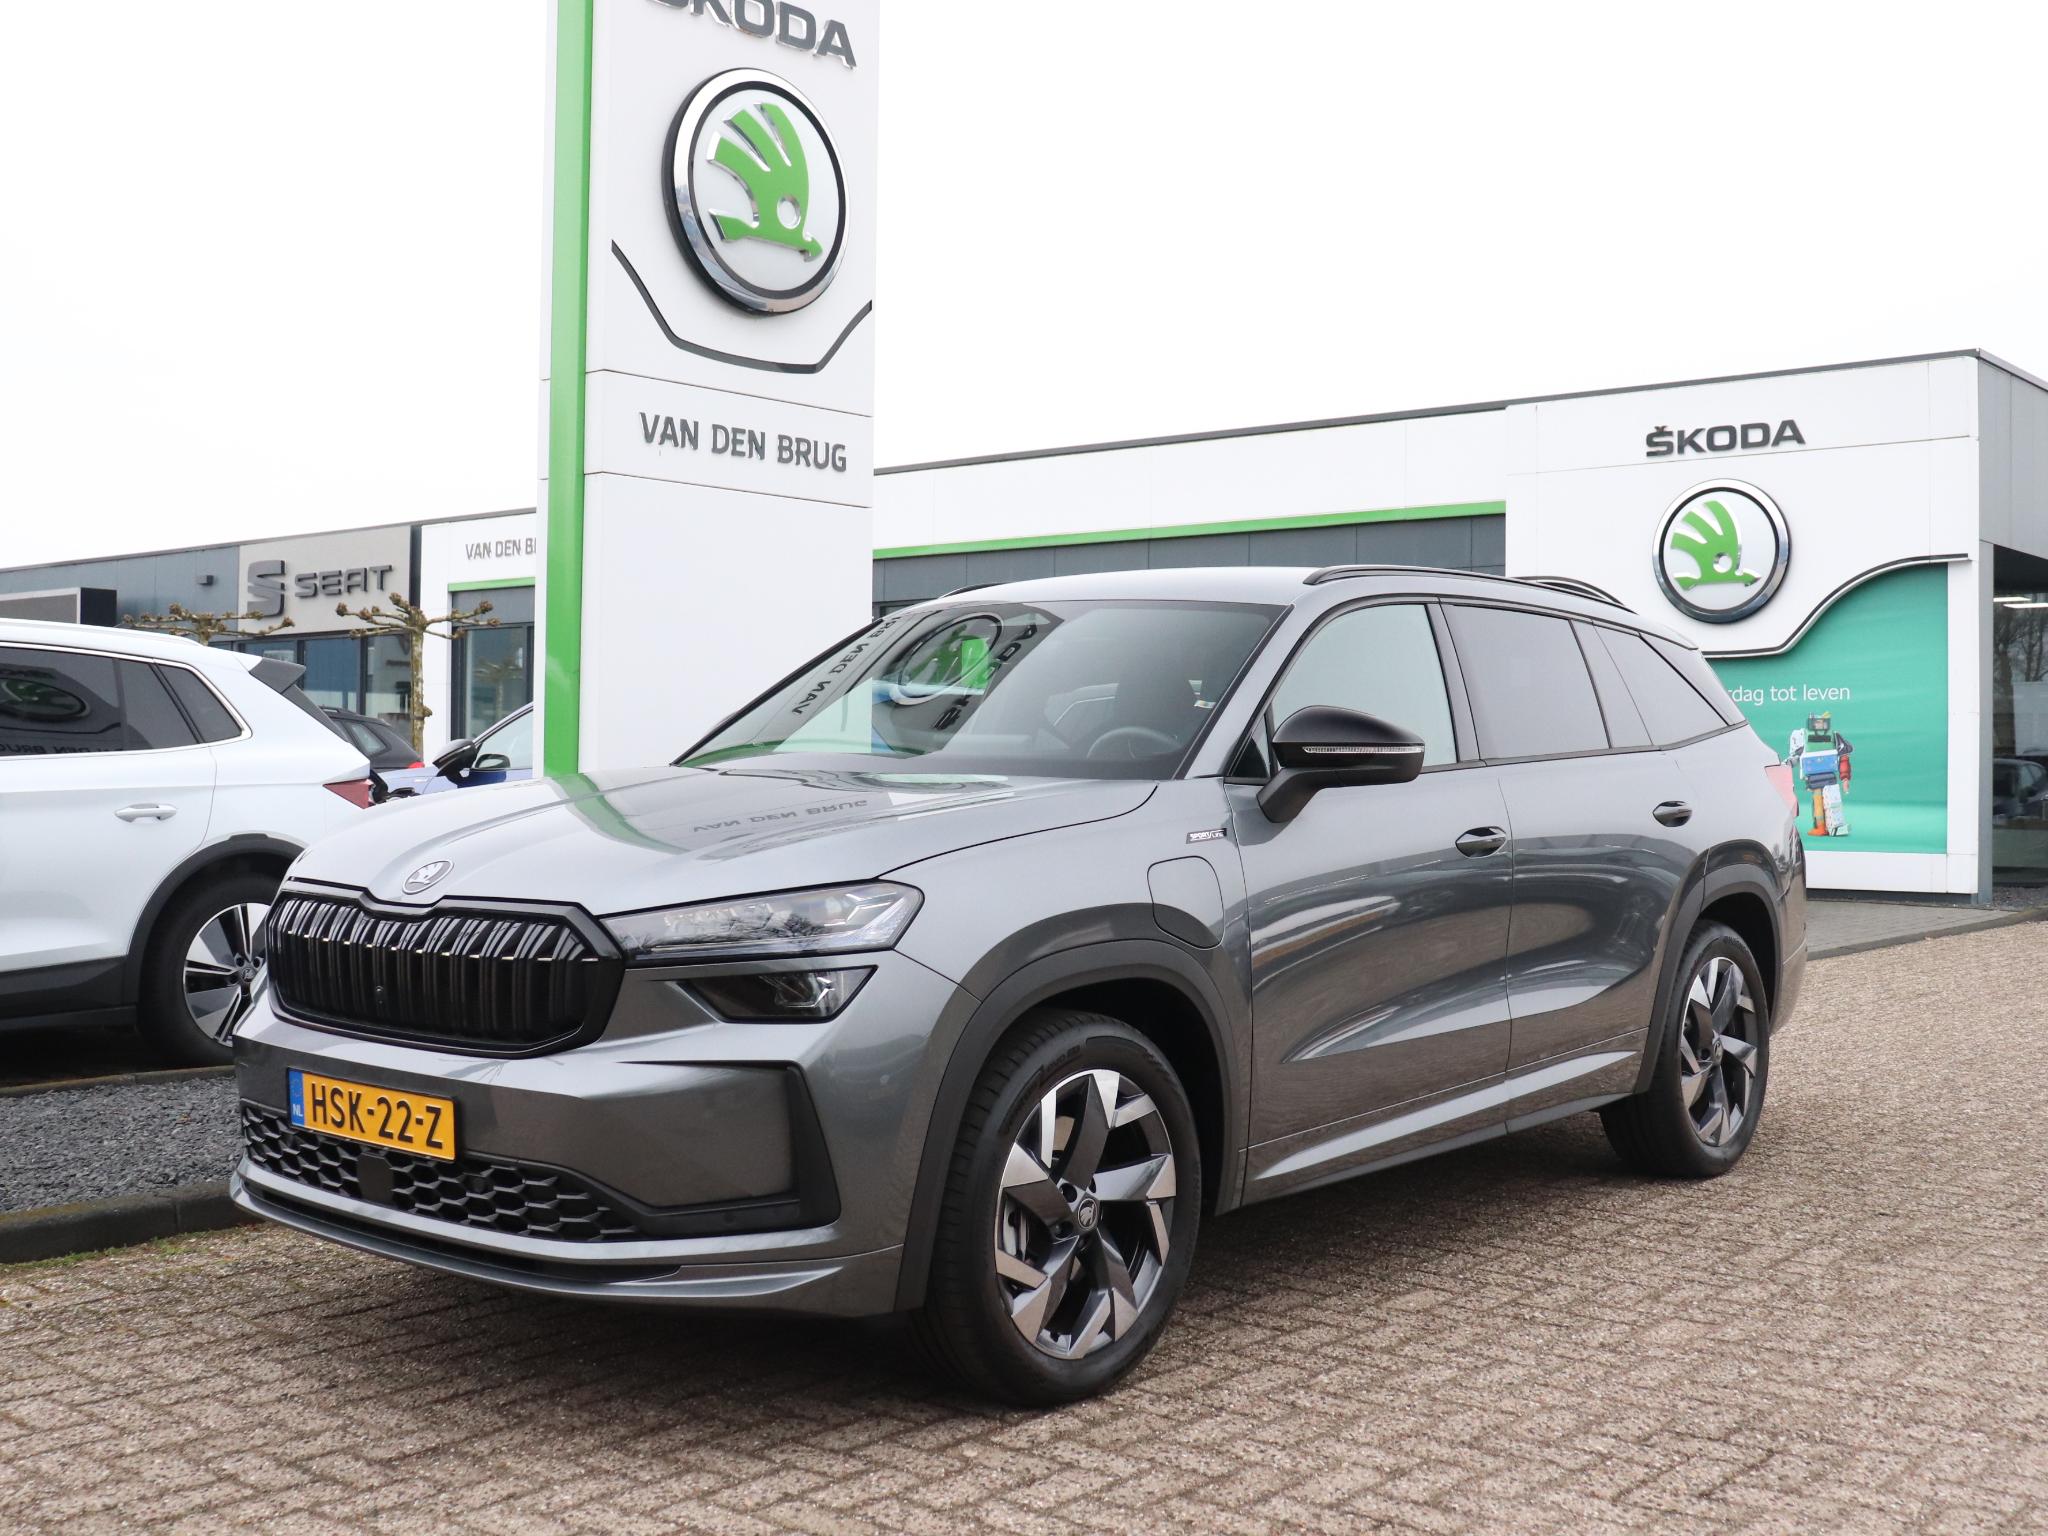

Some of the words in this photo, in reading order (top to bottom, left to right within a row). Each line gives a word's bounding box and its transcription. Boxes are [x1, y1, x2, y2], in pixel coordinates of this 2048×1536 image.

[639, 411, 699, 450] VAN
[711, 423, 766, 460] DEN
[777, 434, 847, 473] BRUG
[1646, 419, 1806, 457] ŠKODA
[465, 541, 492, 560] VAN
[495, 539, 521, 558] DEN
[525, 537, 537, 555] B
[294, 564, 393, 598] SEAT
[1769, 685, 1797, 701] tot
[1803, 684, 1850, 701] leven
[292, 1103, 304, 1117] NL
[311, 1082, 444, 1150] HSK-22-Z
